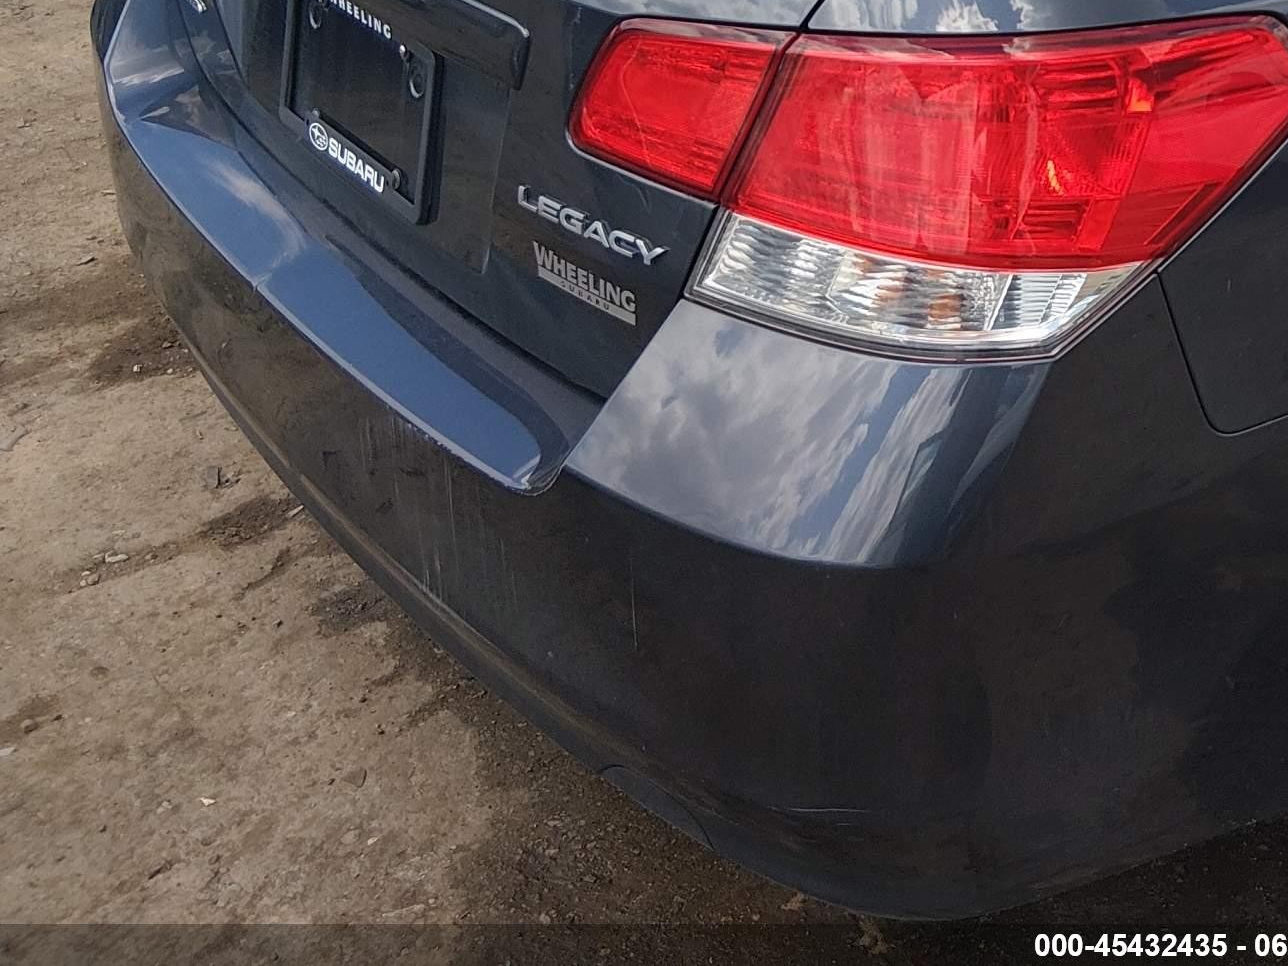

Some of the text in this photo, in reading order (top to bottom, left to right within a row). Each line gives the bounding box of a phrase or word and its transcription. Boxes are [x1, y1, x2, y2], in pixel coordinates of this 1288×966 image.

[327, 137, 385, 193] SUBARU
[517, 185, 666, 266] LEGACY
[532, 240, 637, 313] WHEELING
[559, 279, 611, 312] SUBARU
